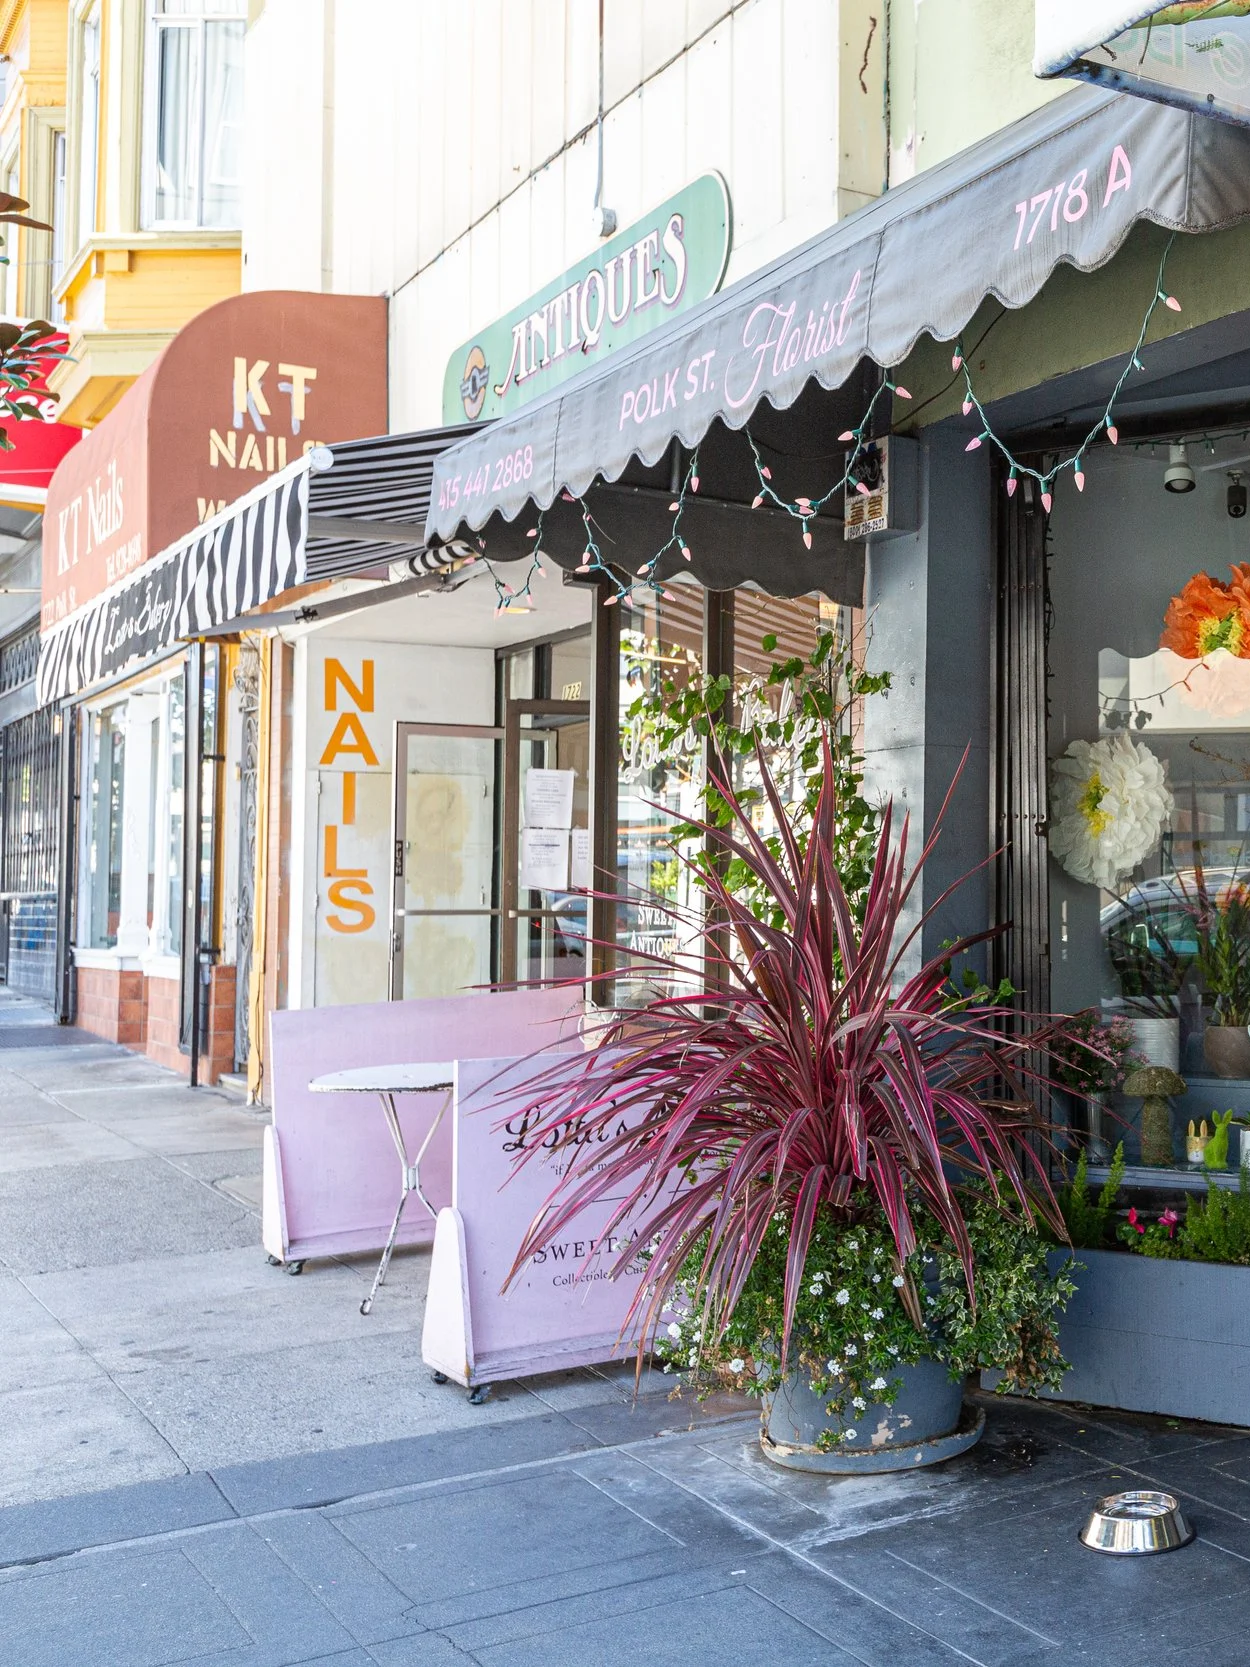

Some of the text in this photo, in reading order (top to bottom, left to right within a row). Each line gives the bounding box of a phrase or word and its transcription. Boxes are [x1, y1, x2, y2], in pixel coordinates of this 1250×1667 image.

[1013, 144, 1132, 251] 1718 A
[494, 214, 687, 396] ANTIQUES
[619, 269, 861, 432] POLK ST. Florist
[232, 357, 318, 421] KT
[57, 496, 82, 577] KT
[86, 459, 124, 554] Nails
[438, 445, 533, 512] 415 441 2868
[319, 658, 380, 934] NAILS
